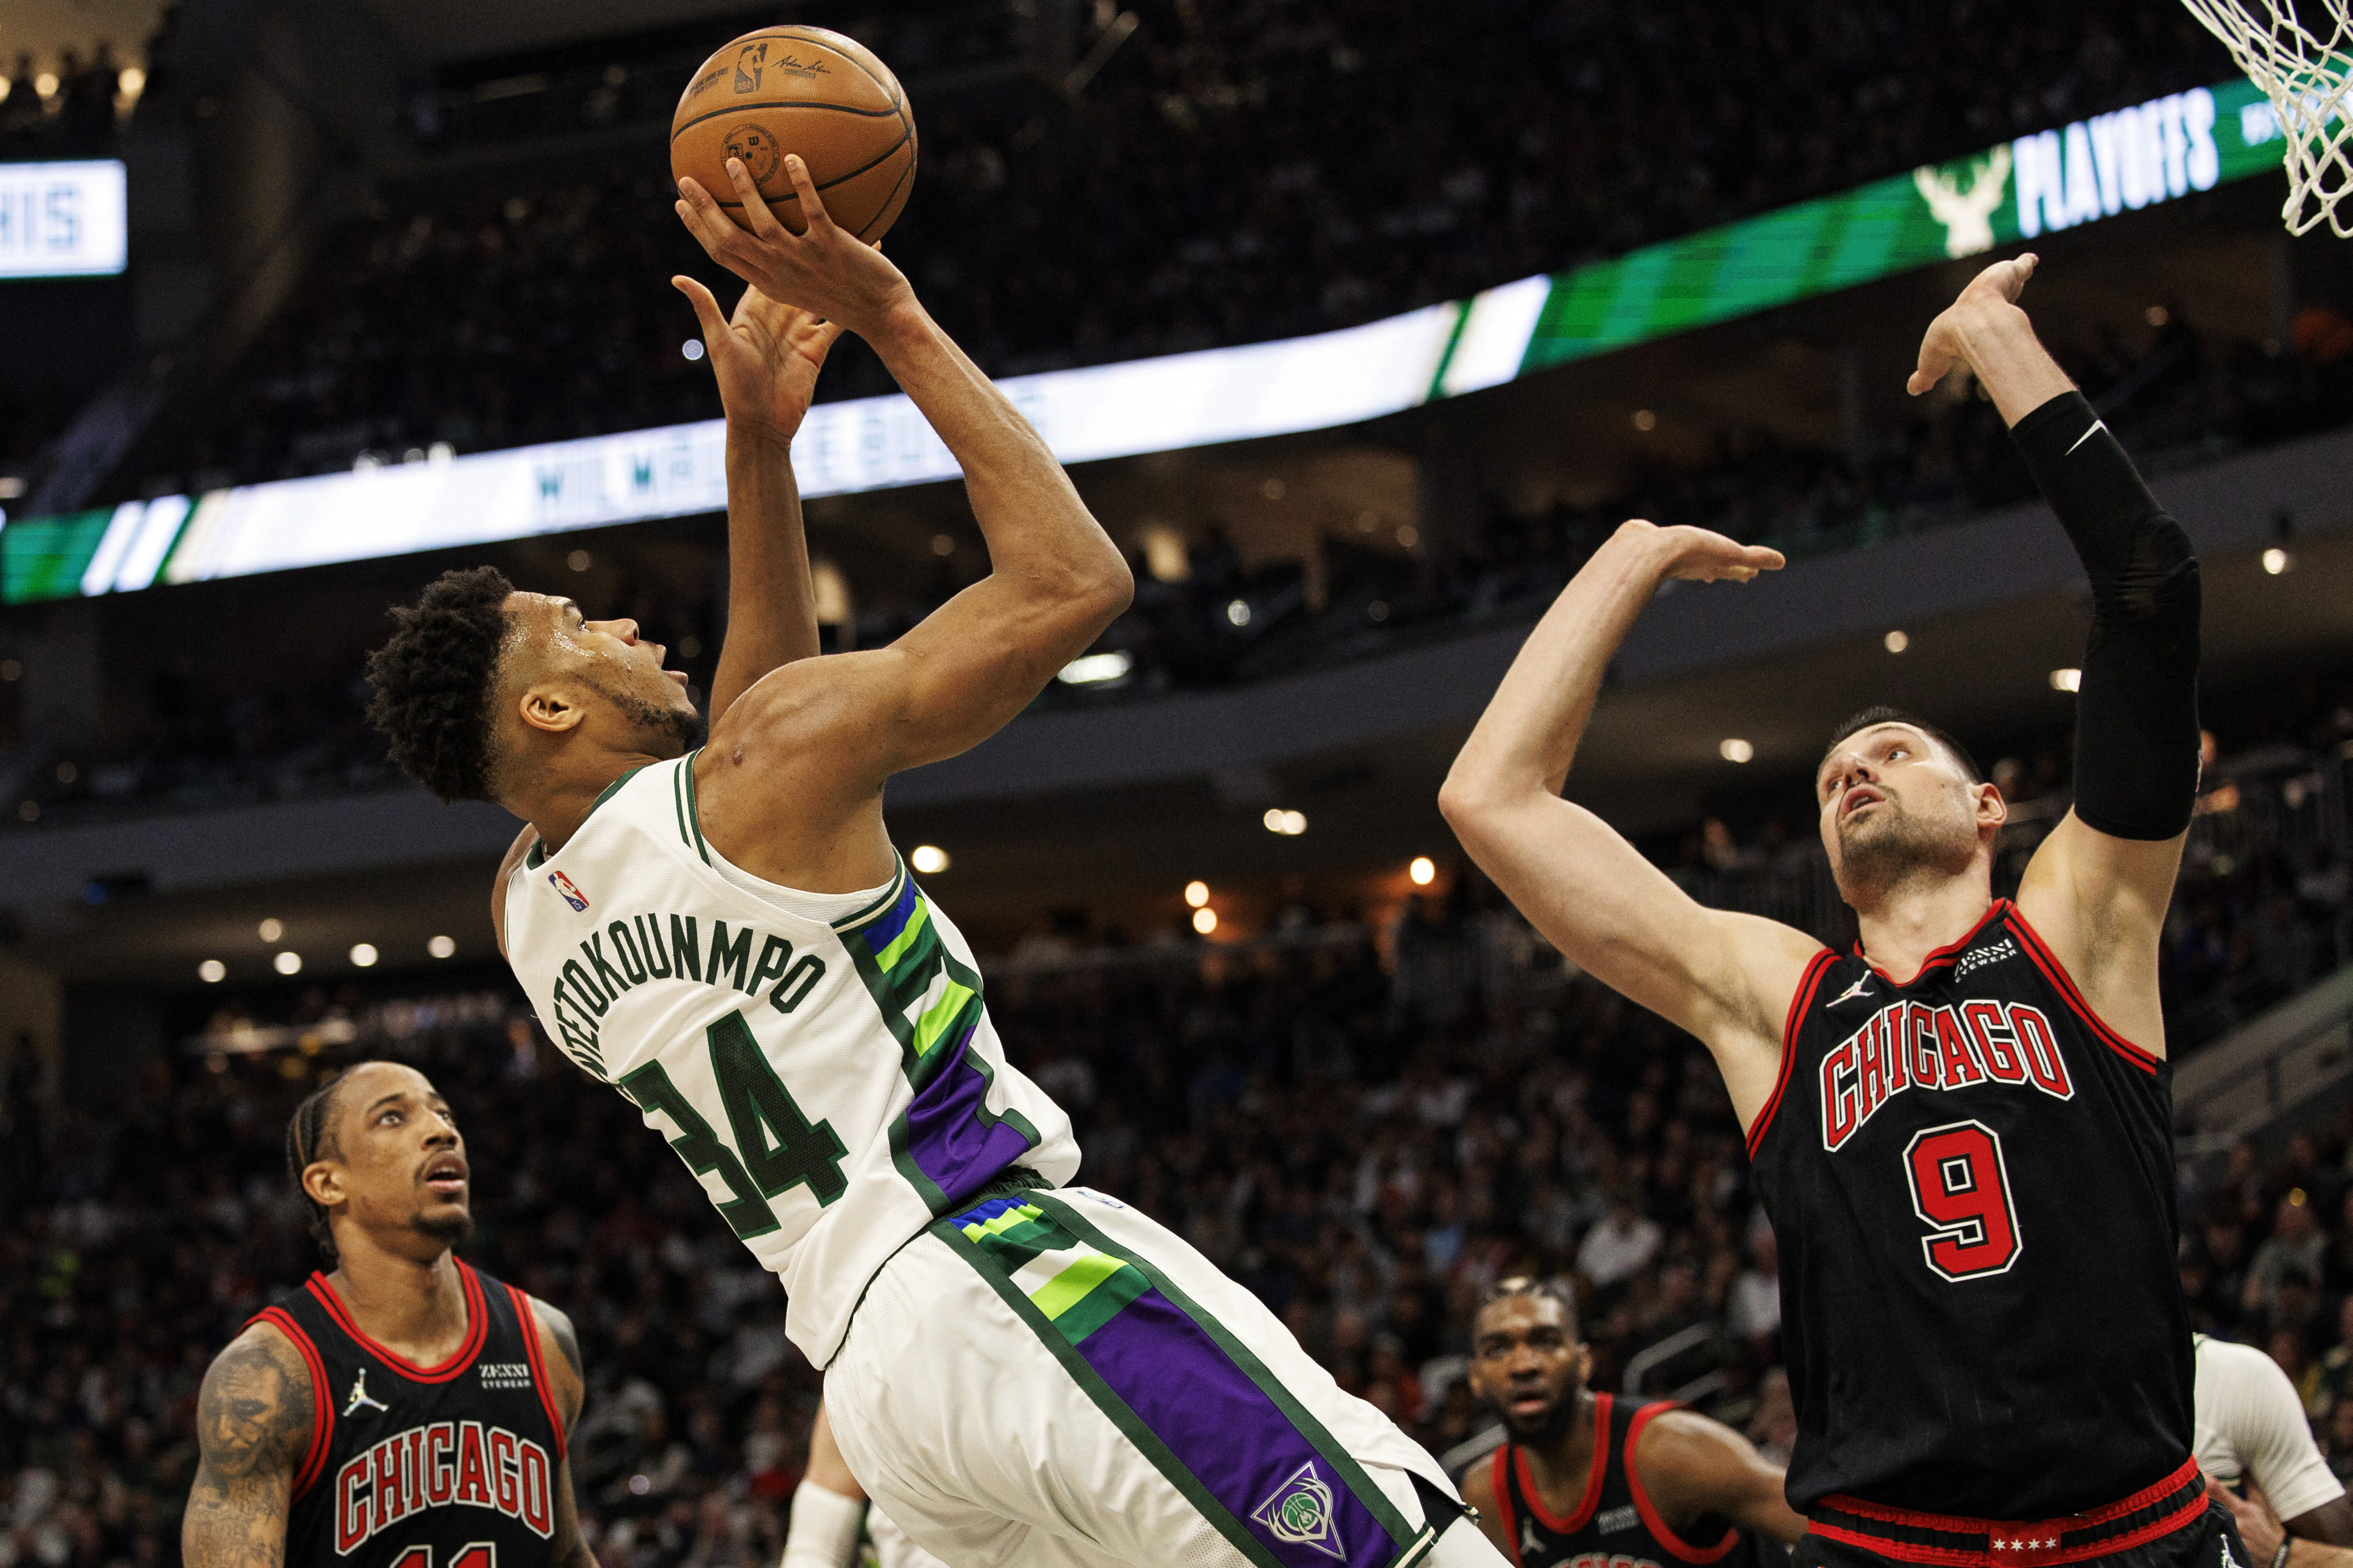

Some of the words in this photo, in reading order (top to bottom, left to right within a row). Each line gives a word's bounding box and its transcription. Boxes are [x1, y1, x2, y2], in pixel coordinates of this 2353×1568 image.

[618, 1009, 850, 1241] 34
[1819, 1000, 2075, 1153] CHICAGO
[1903, 1119, 2023, 1283] 9
[335, 1421, 554, 1556] CHICAGO
